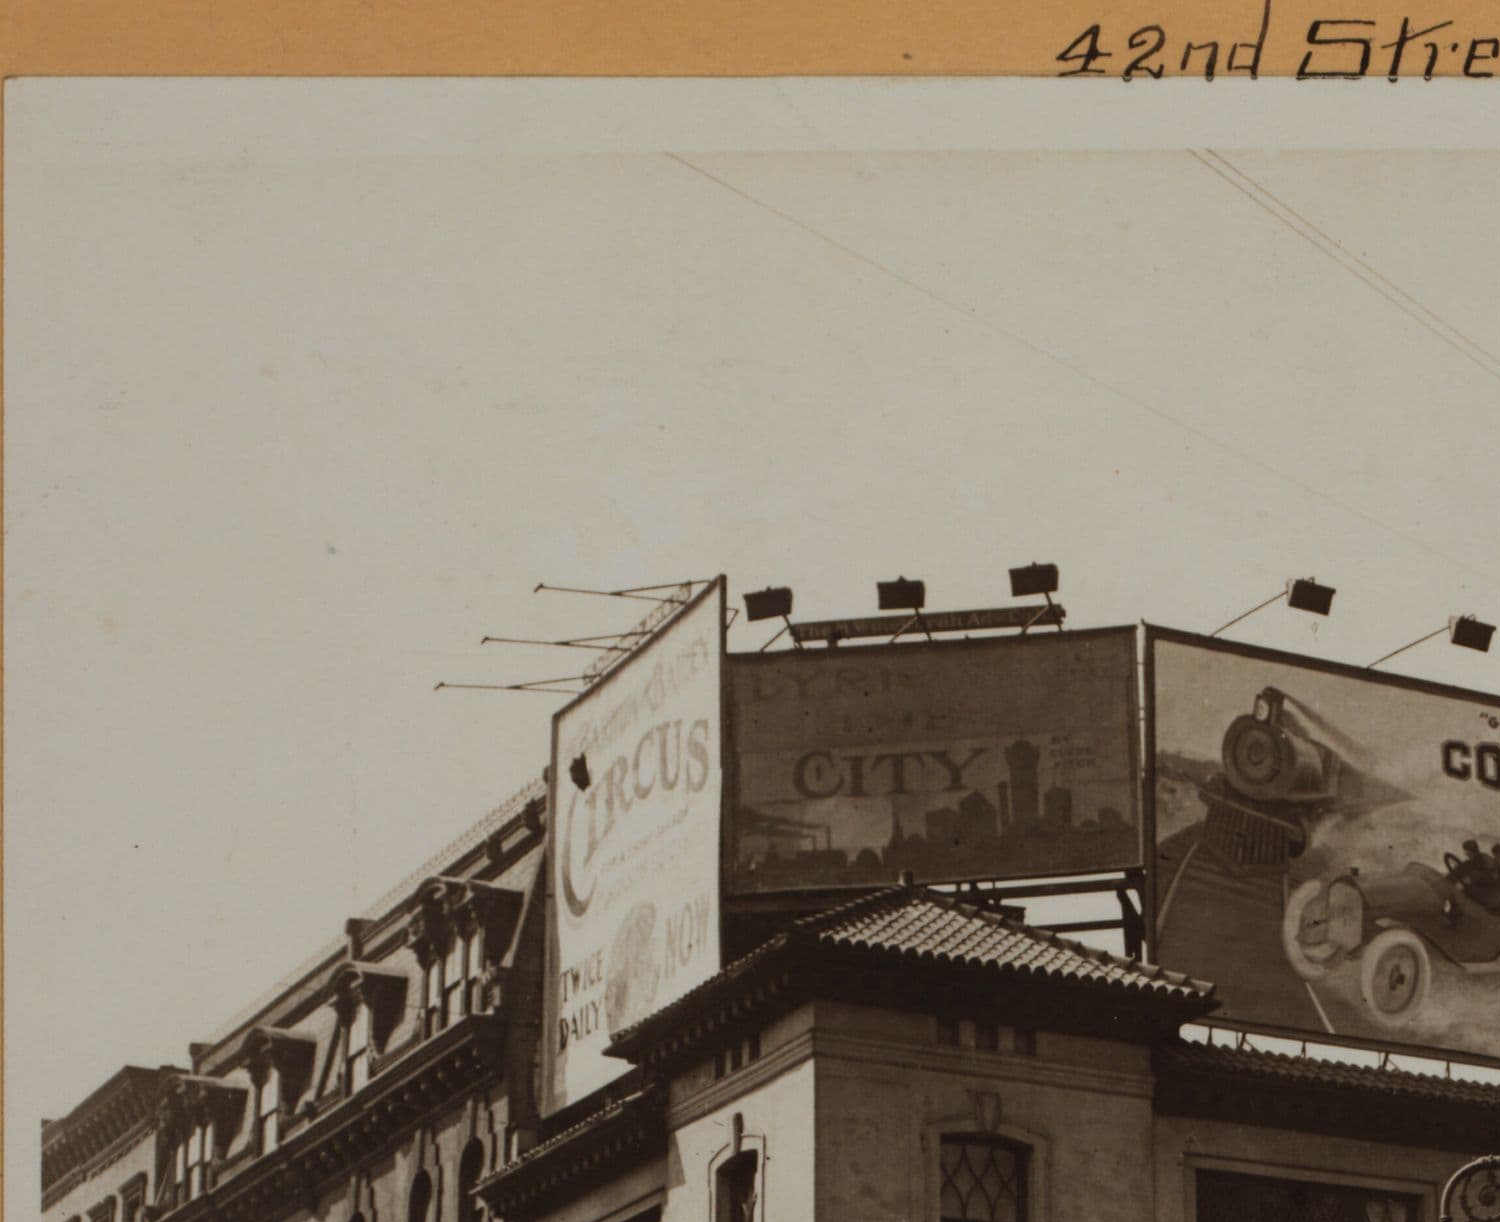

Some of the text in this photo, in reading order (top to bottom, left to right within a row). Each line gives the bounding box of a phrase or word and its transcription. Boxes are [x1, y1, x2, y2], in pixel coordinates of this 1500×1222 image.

[1055, 0, 1267, 79] 42nd
[794, 746, 989, 799] CITY
[561, 716, 711, 920] CIRCUS
[562, 948, 604, 1002] TWICE
[559, 1001, 602, 1056] DAILY
